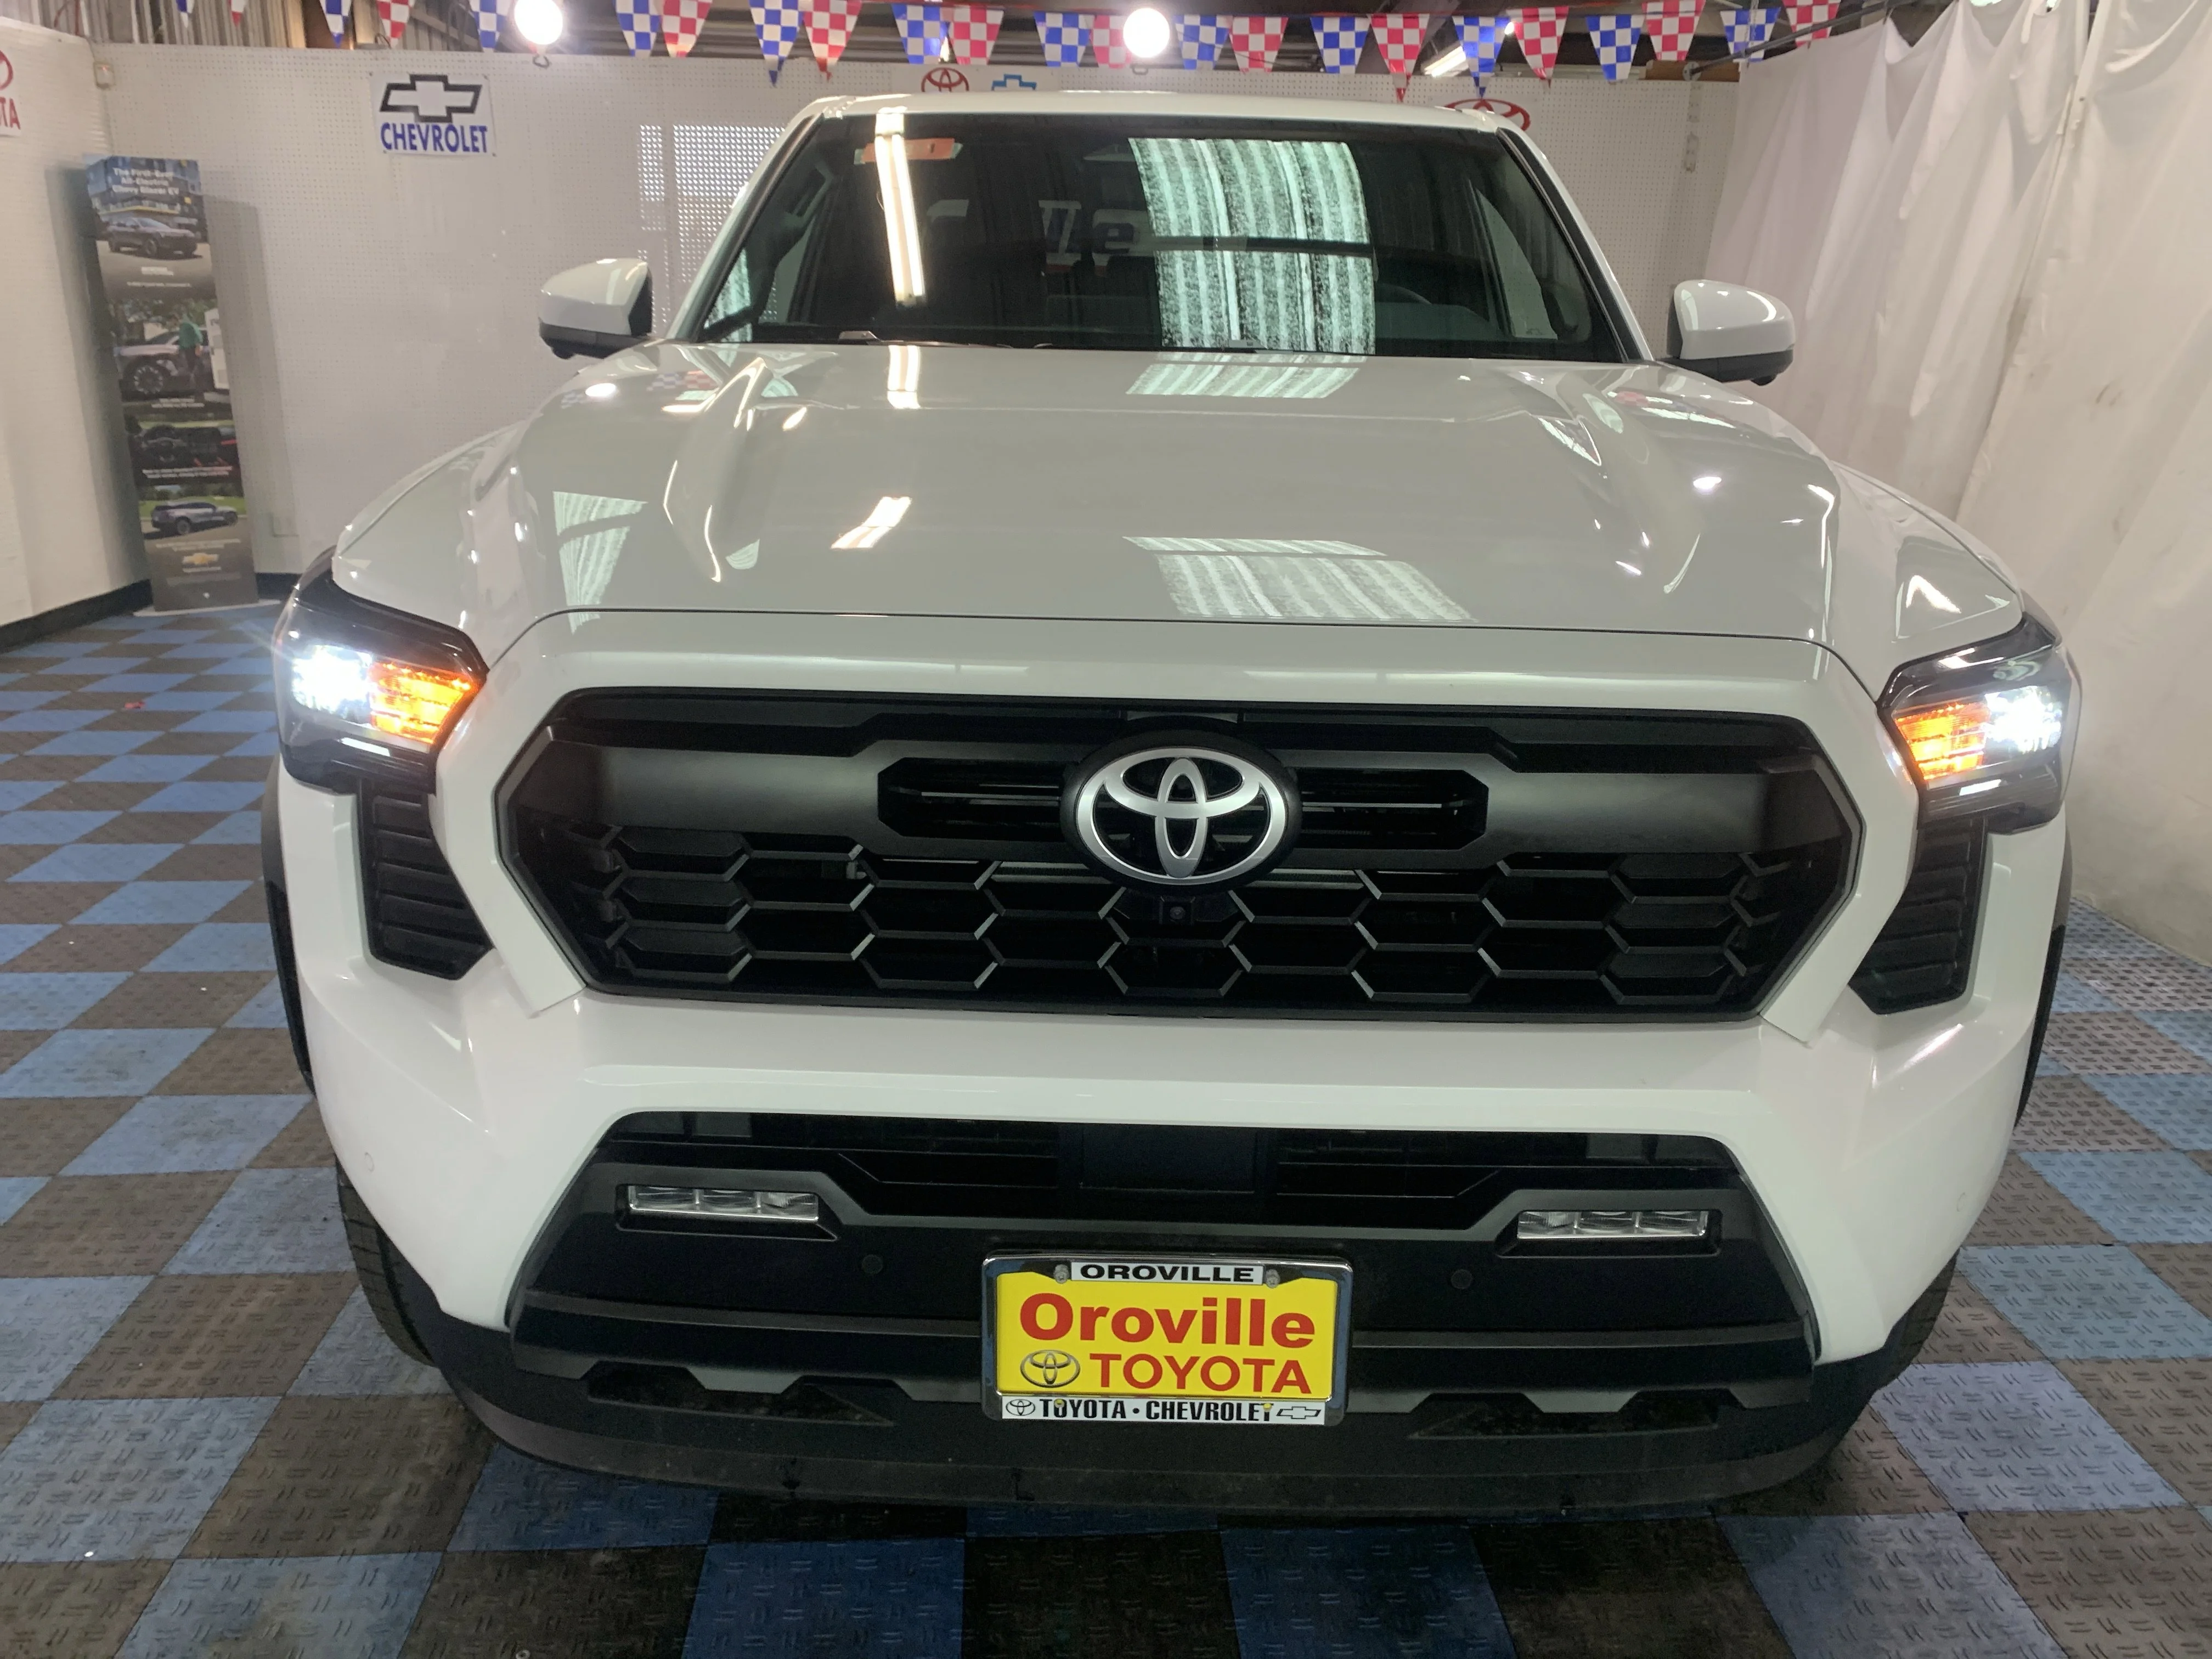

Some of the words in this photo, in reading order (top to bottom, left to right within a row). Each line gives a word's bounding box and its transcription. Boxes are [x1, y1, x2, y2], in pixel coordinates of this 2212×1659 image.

[380, 122, 488, 153] CHEVROLET
[1080, 1263, 1255, 1283] OROVILLE
[1019, 1292, 1316, 1349] Oroville
[1089, 1352, 1312, 1395] TOYOTA
[1039, 1398, 1127, 1419] TOYOTA
[1146, 1400, 1274, 1421] CHEVROLET
